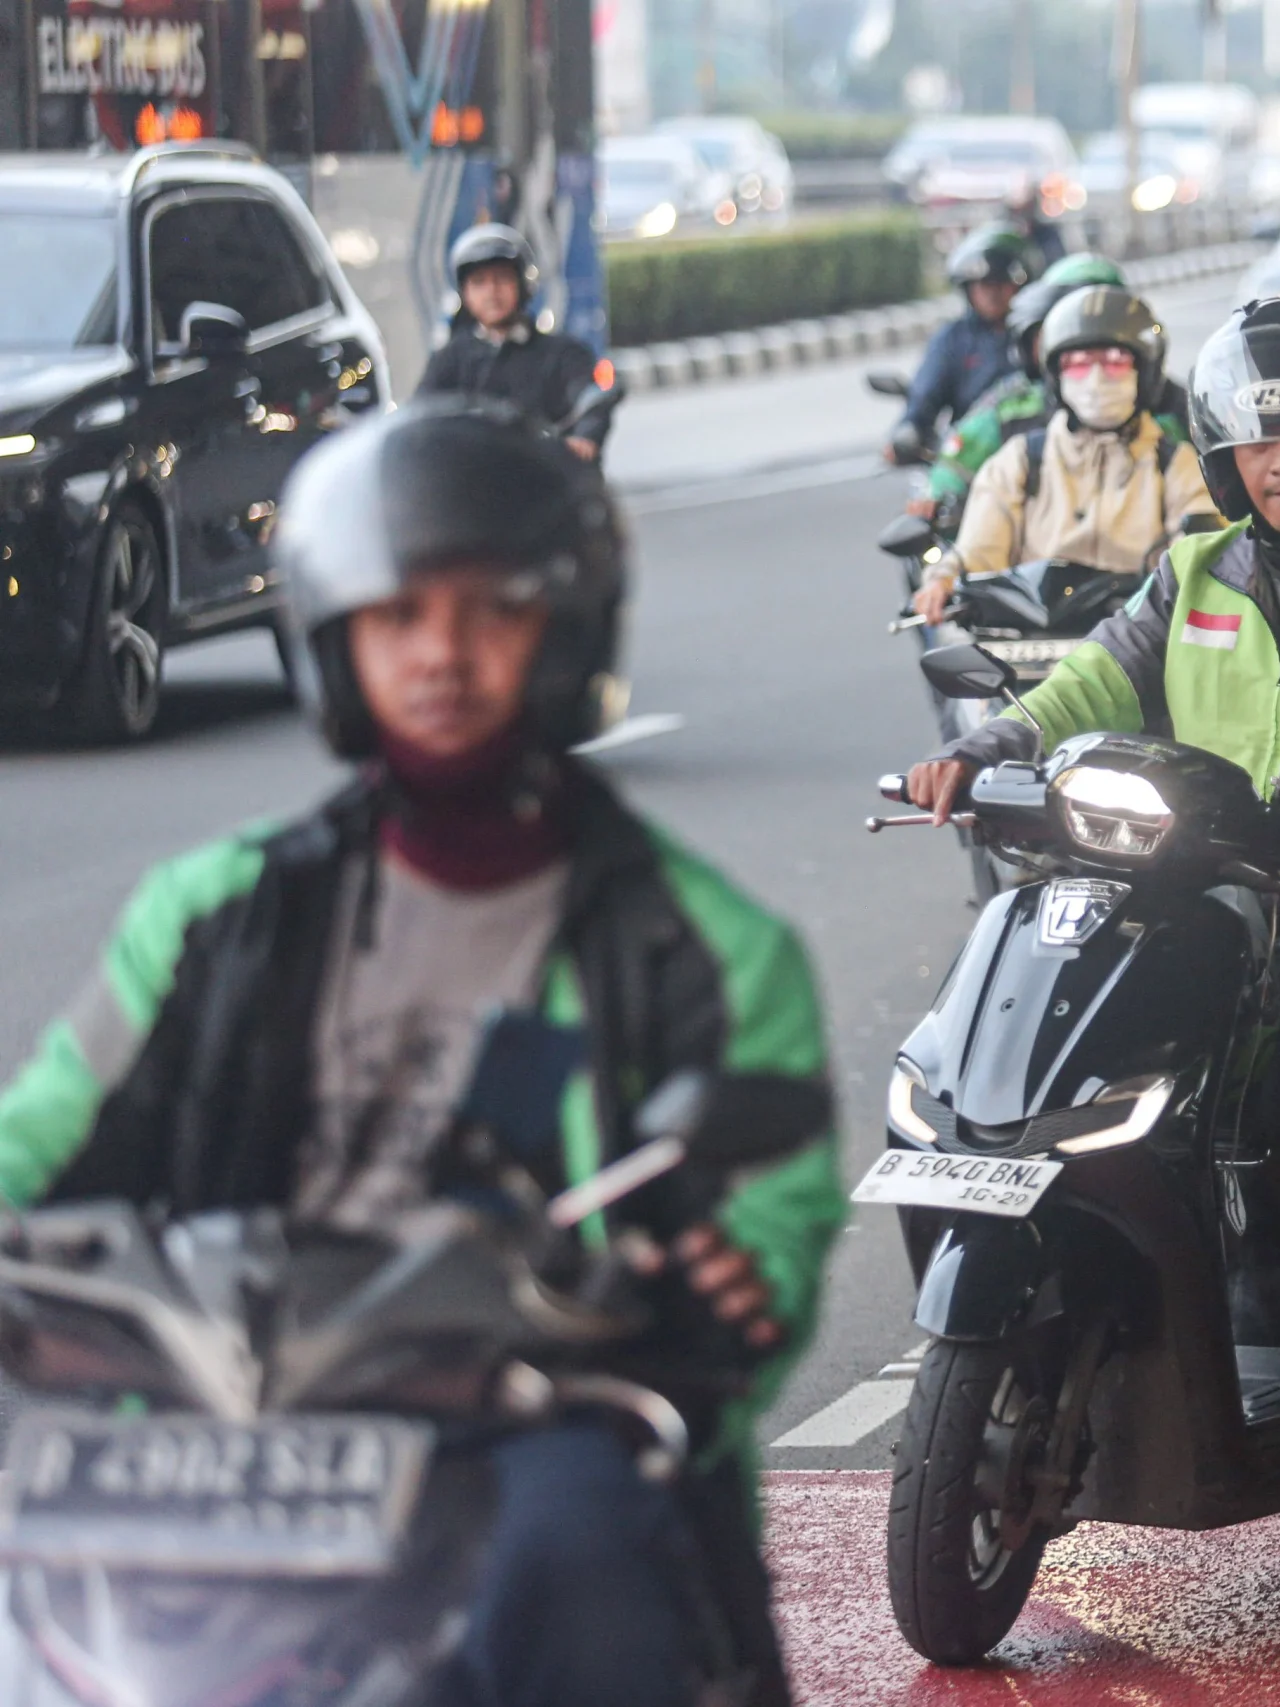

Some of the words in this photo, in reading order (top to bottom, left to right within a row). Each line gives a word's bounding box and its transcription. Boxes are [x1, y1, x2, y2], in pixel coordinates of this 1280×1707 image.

[157, 18, 207, 98] BUS
[876, 1154, 902, 1175] B
[908, 1156, 987, 1180] 5940
[987, 1162, 1044, 1189] BNL
